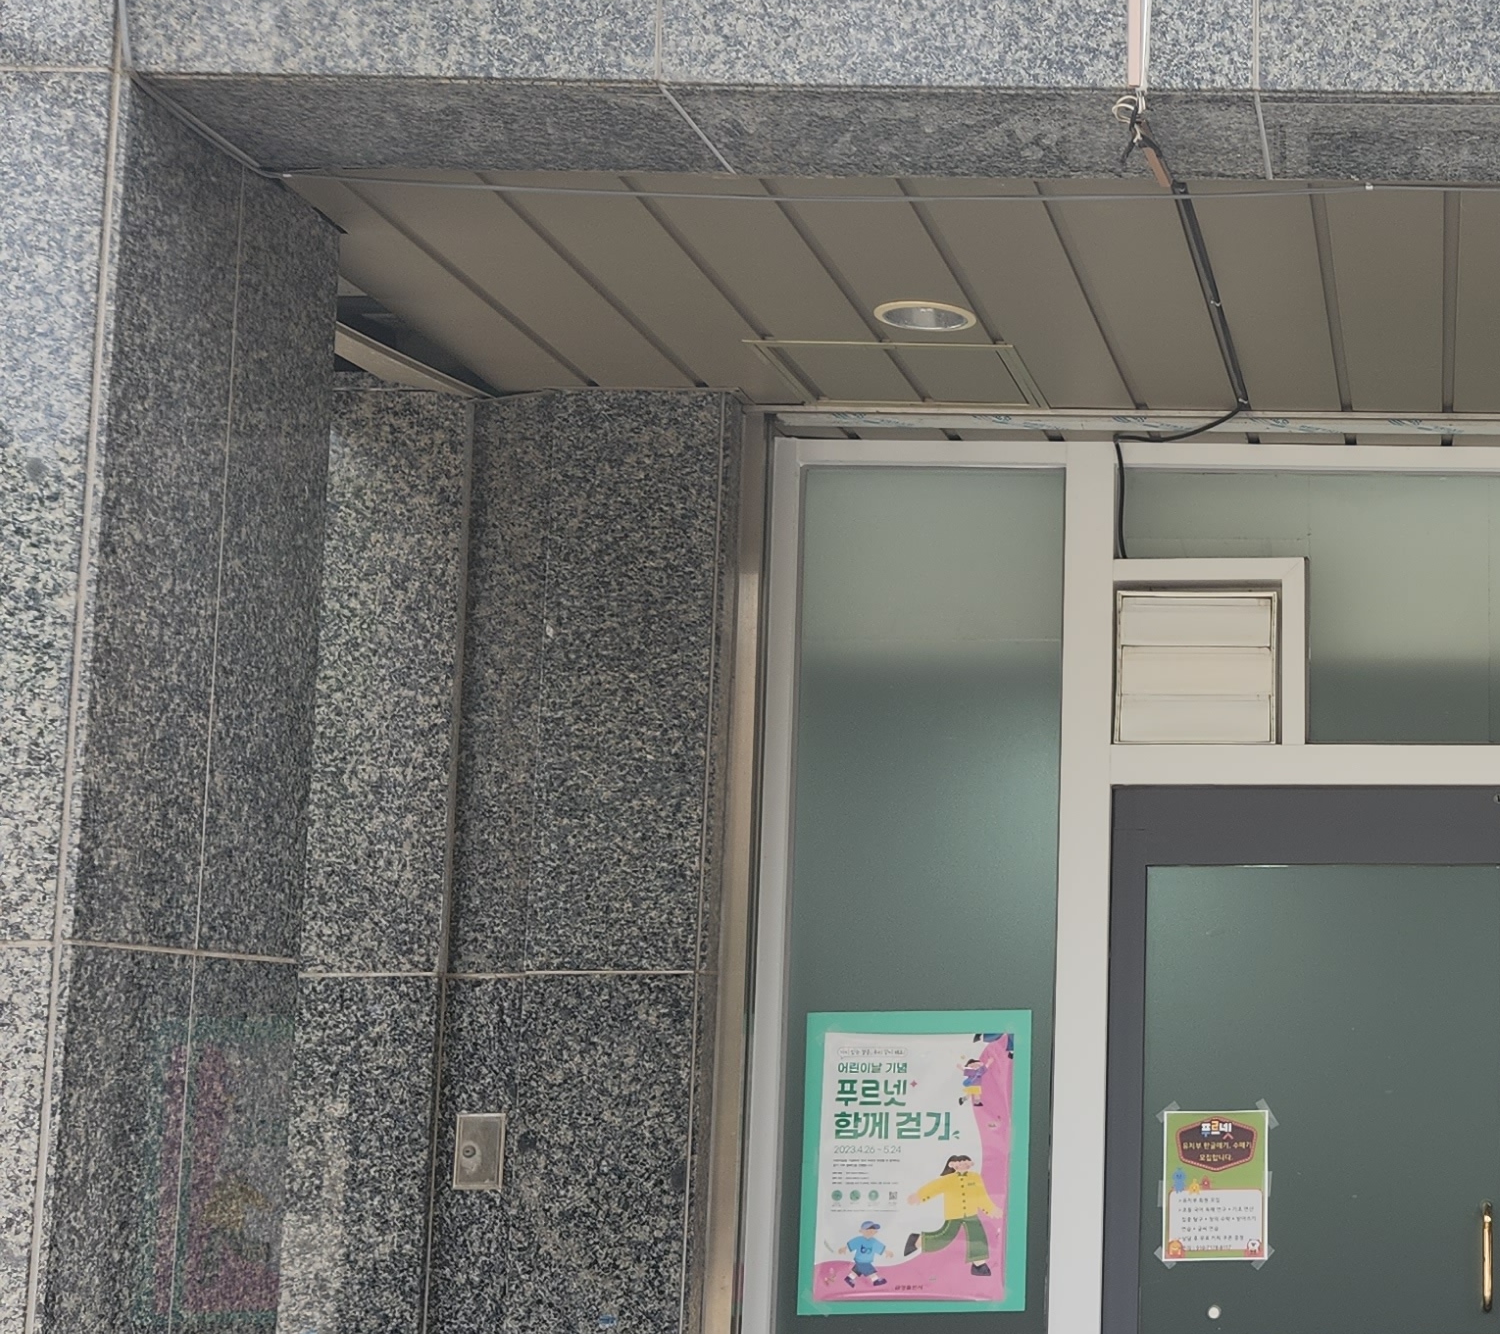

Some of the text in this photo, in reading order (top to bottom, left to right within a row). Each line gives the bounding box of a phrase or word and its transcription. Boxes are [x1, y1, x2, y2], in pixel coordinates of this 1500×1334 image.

[837, 1062, 908, 1074] 어린이날 기념
[835, 1079, 907, 1107] 푸르넷
[834, 1111, 951, 1141] 함께 걷기
[1201, 1120, 1234, 1140] 푸르넷
[1183, 1142, 1201, 1150] 유치부
